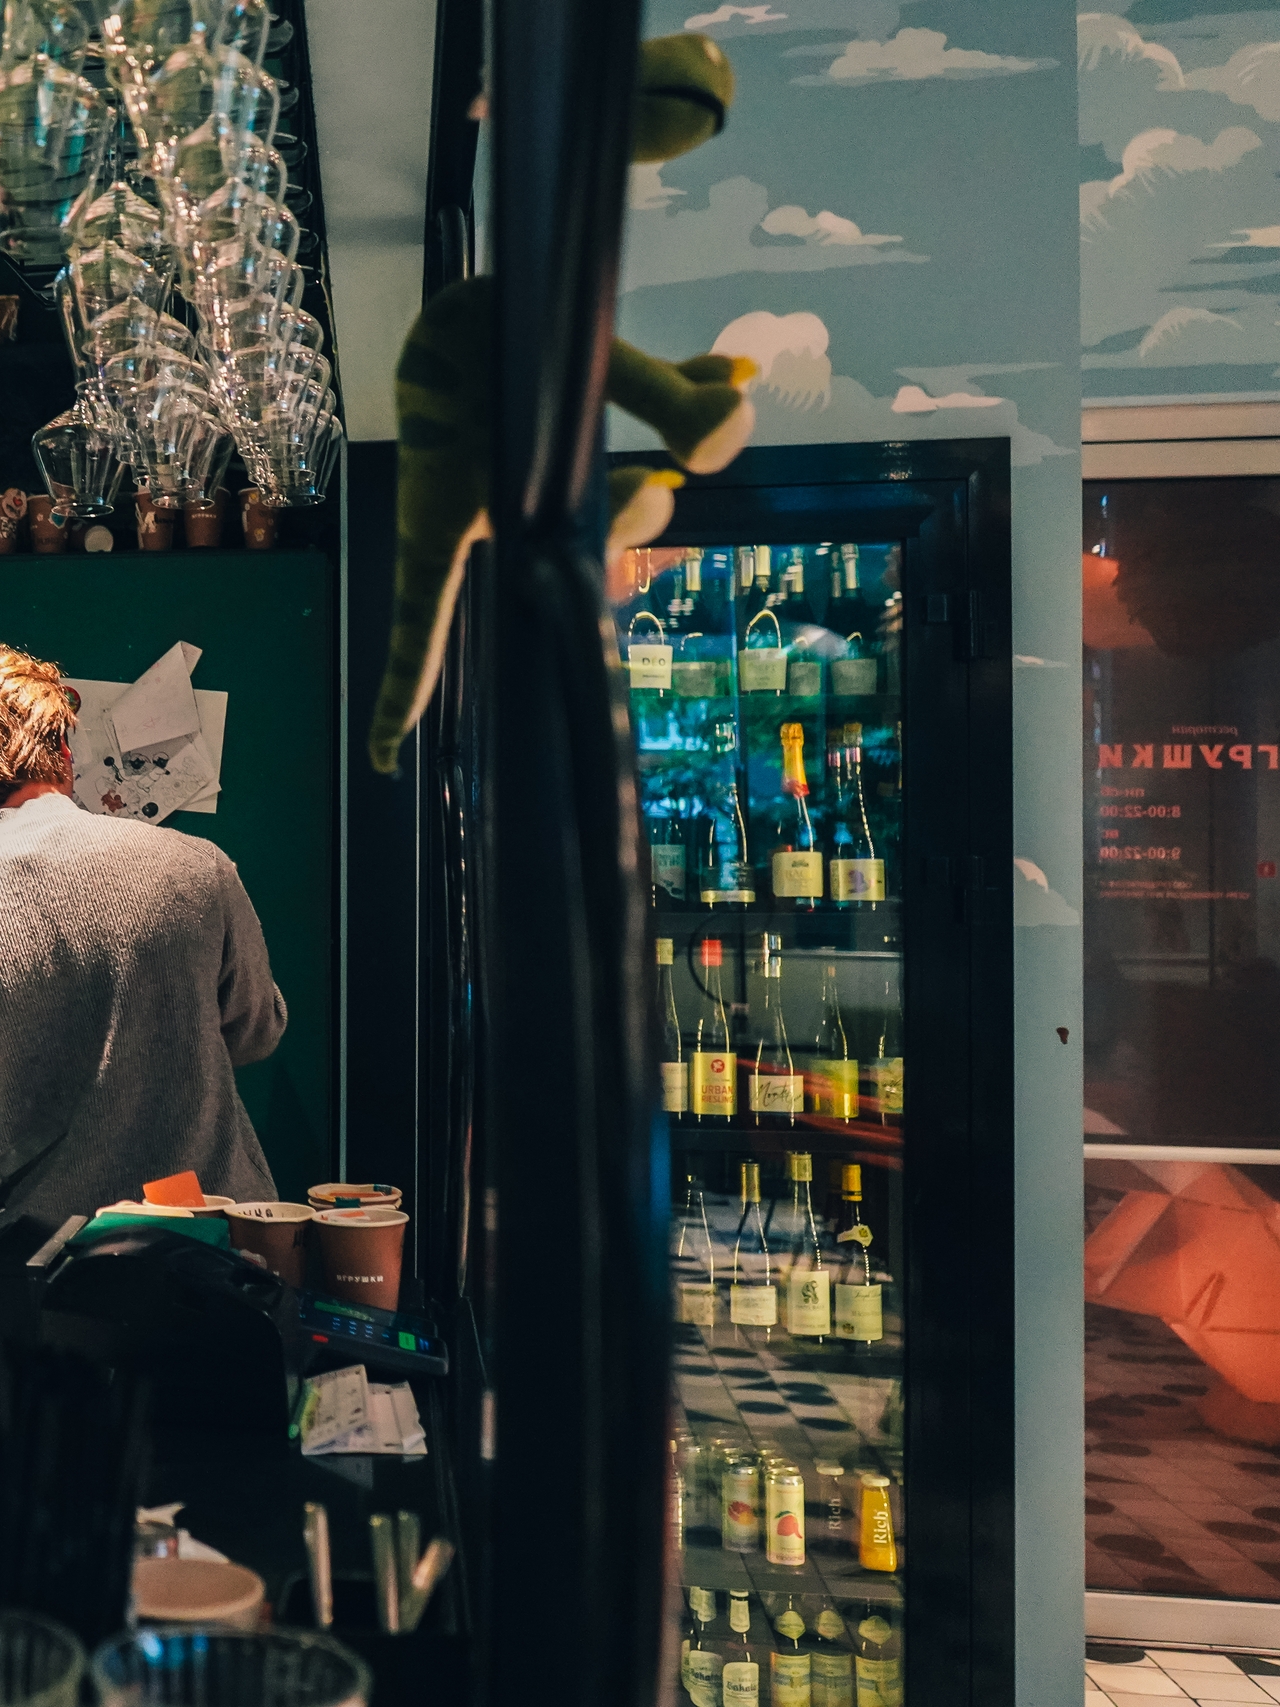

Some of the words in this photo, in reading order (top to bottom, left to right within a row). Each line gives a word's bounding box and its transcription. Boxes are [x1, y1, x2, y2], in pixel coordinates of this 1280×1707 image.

[701, 1084, 733, 1095] URBAN
[828, 1497, 841, 1531] Rich
[873, 1512, 889, 1545] Rich
